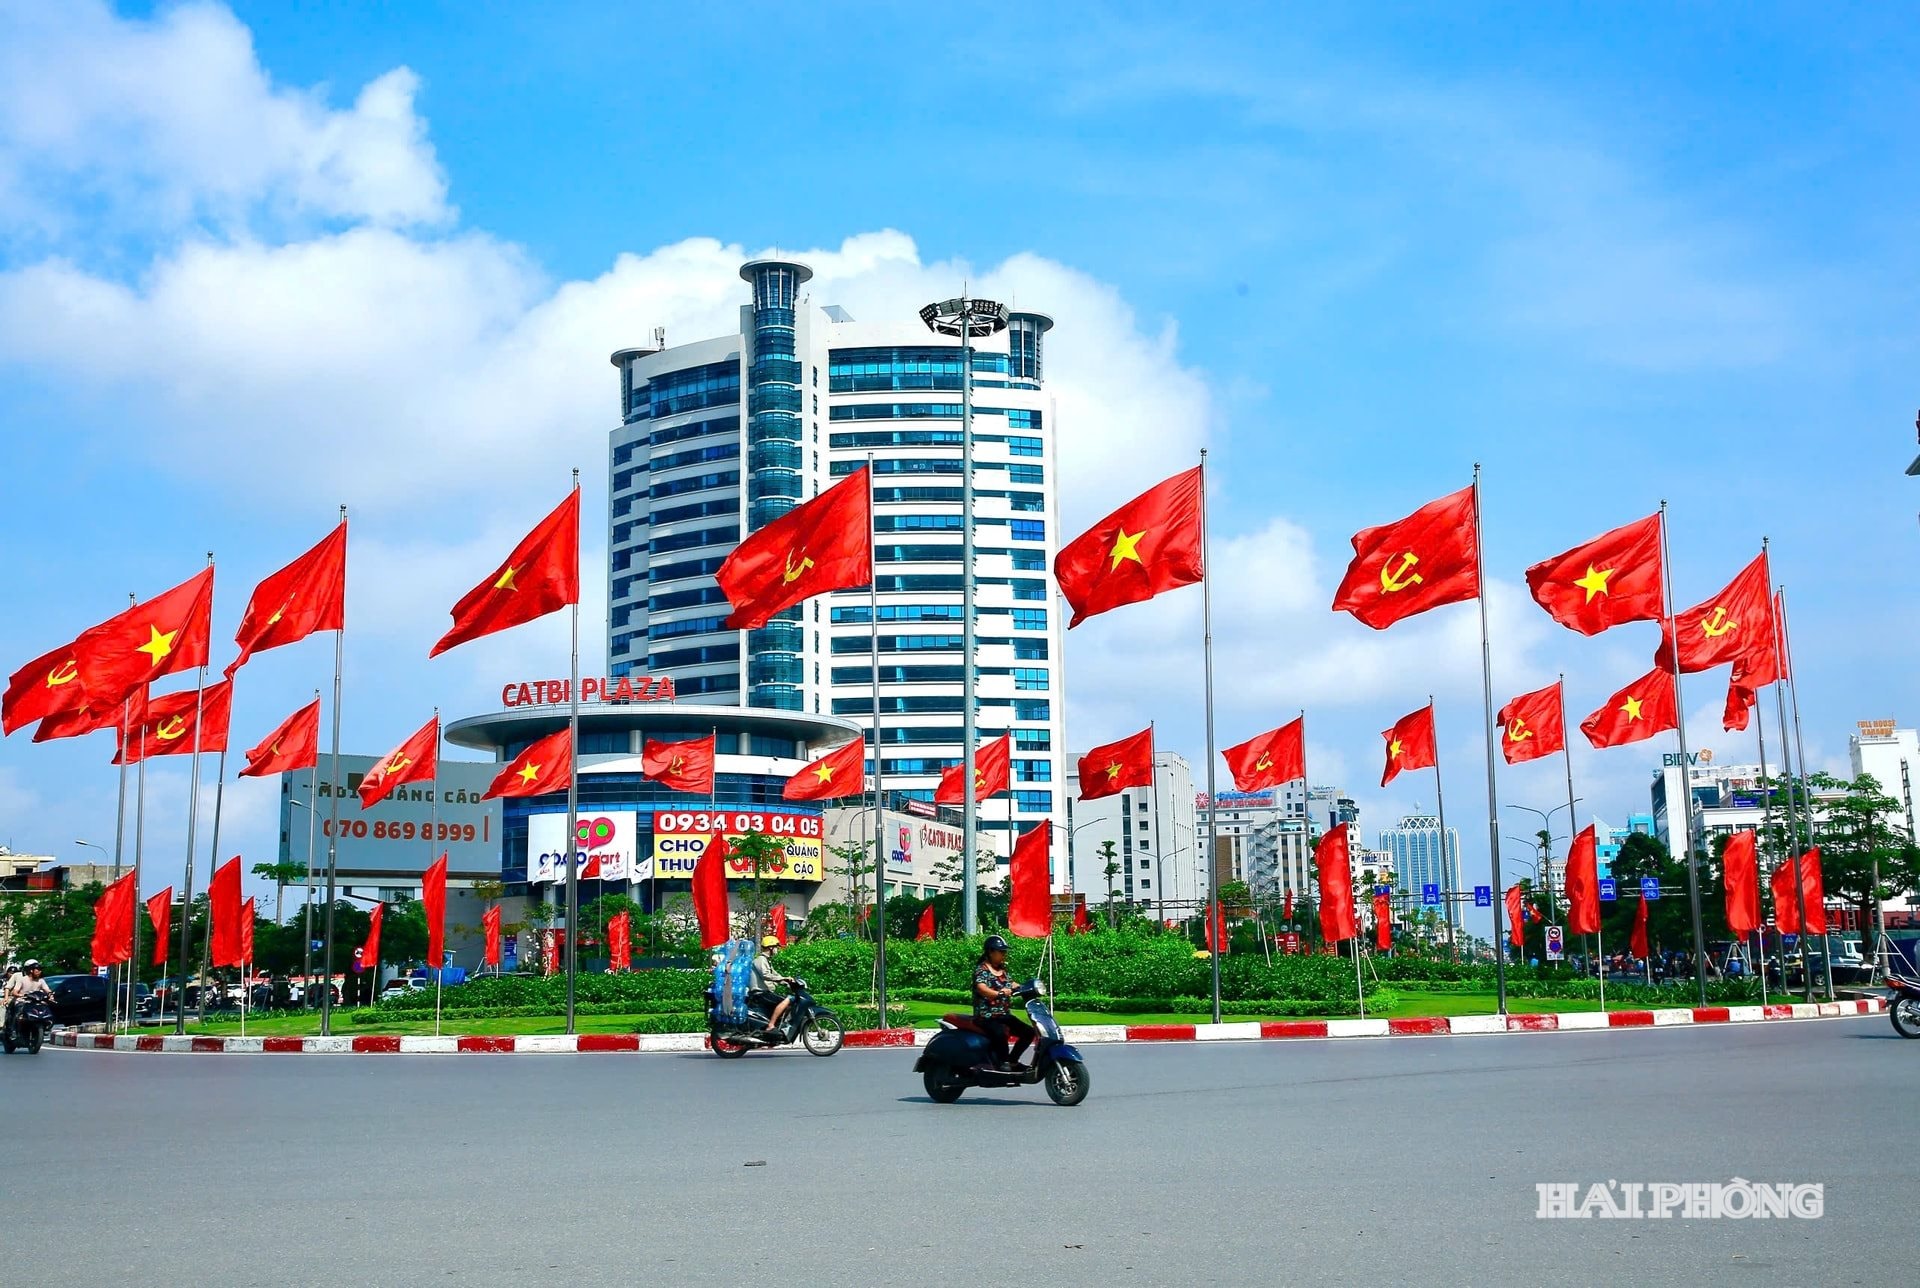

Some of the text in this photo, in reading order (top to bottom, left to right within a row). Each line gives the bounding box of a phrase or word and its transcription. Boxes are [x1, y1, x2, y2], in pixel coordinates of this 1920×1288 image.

[502, 676, 676, 707] CATBI PLAZA
[323, 819, 476, 842] 070 869 8999
[659, 813, 819, 836] 0934 03 04 05
[659, 839, 705, 852] CHO
[659, 855, 701, 872] THU
